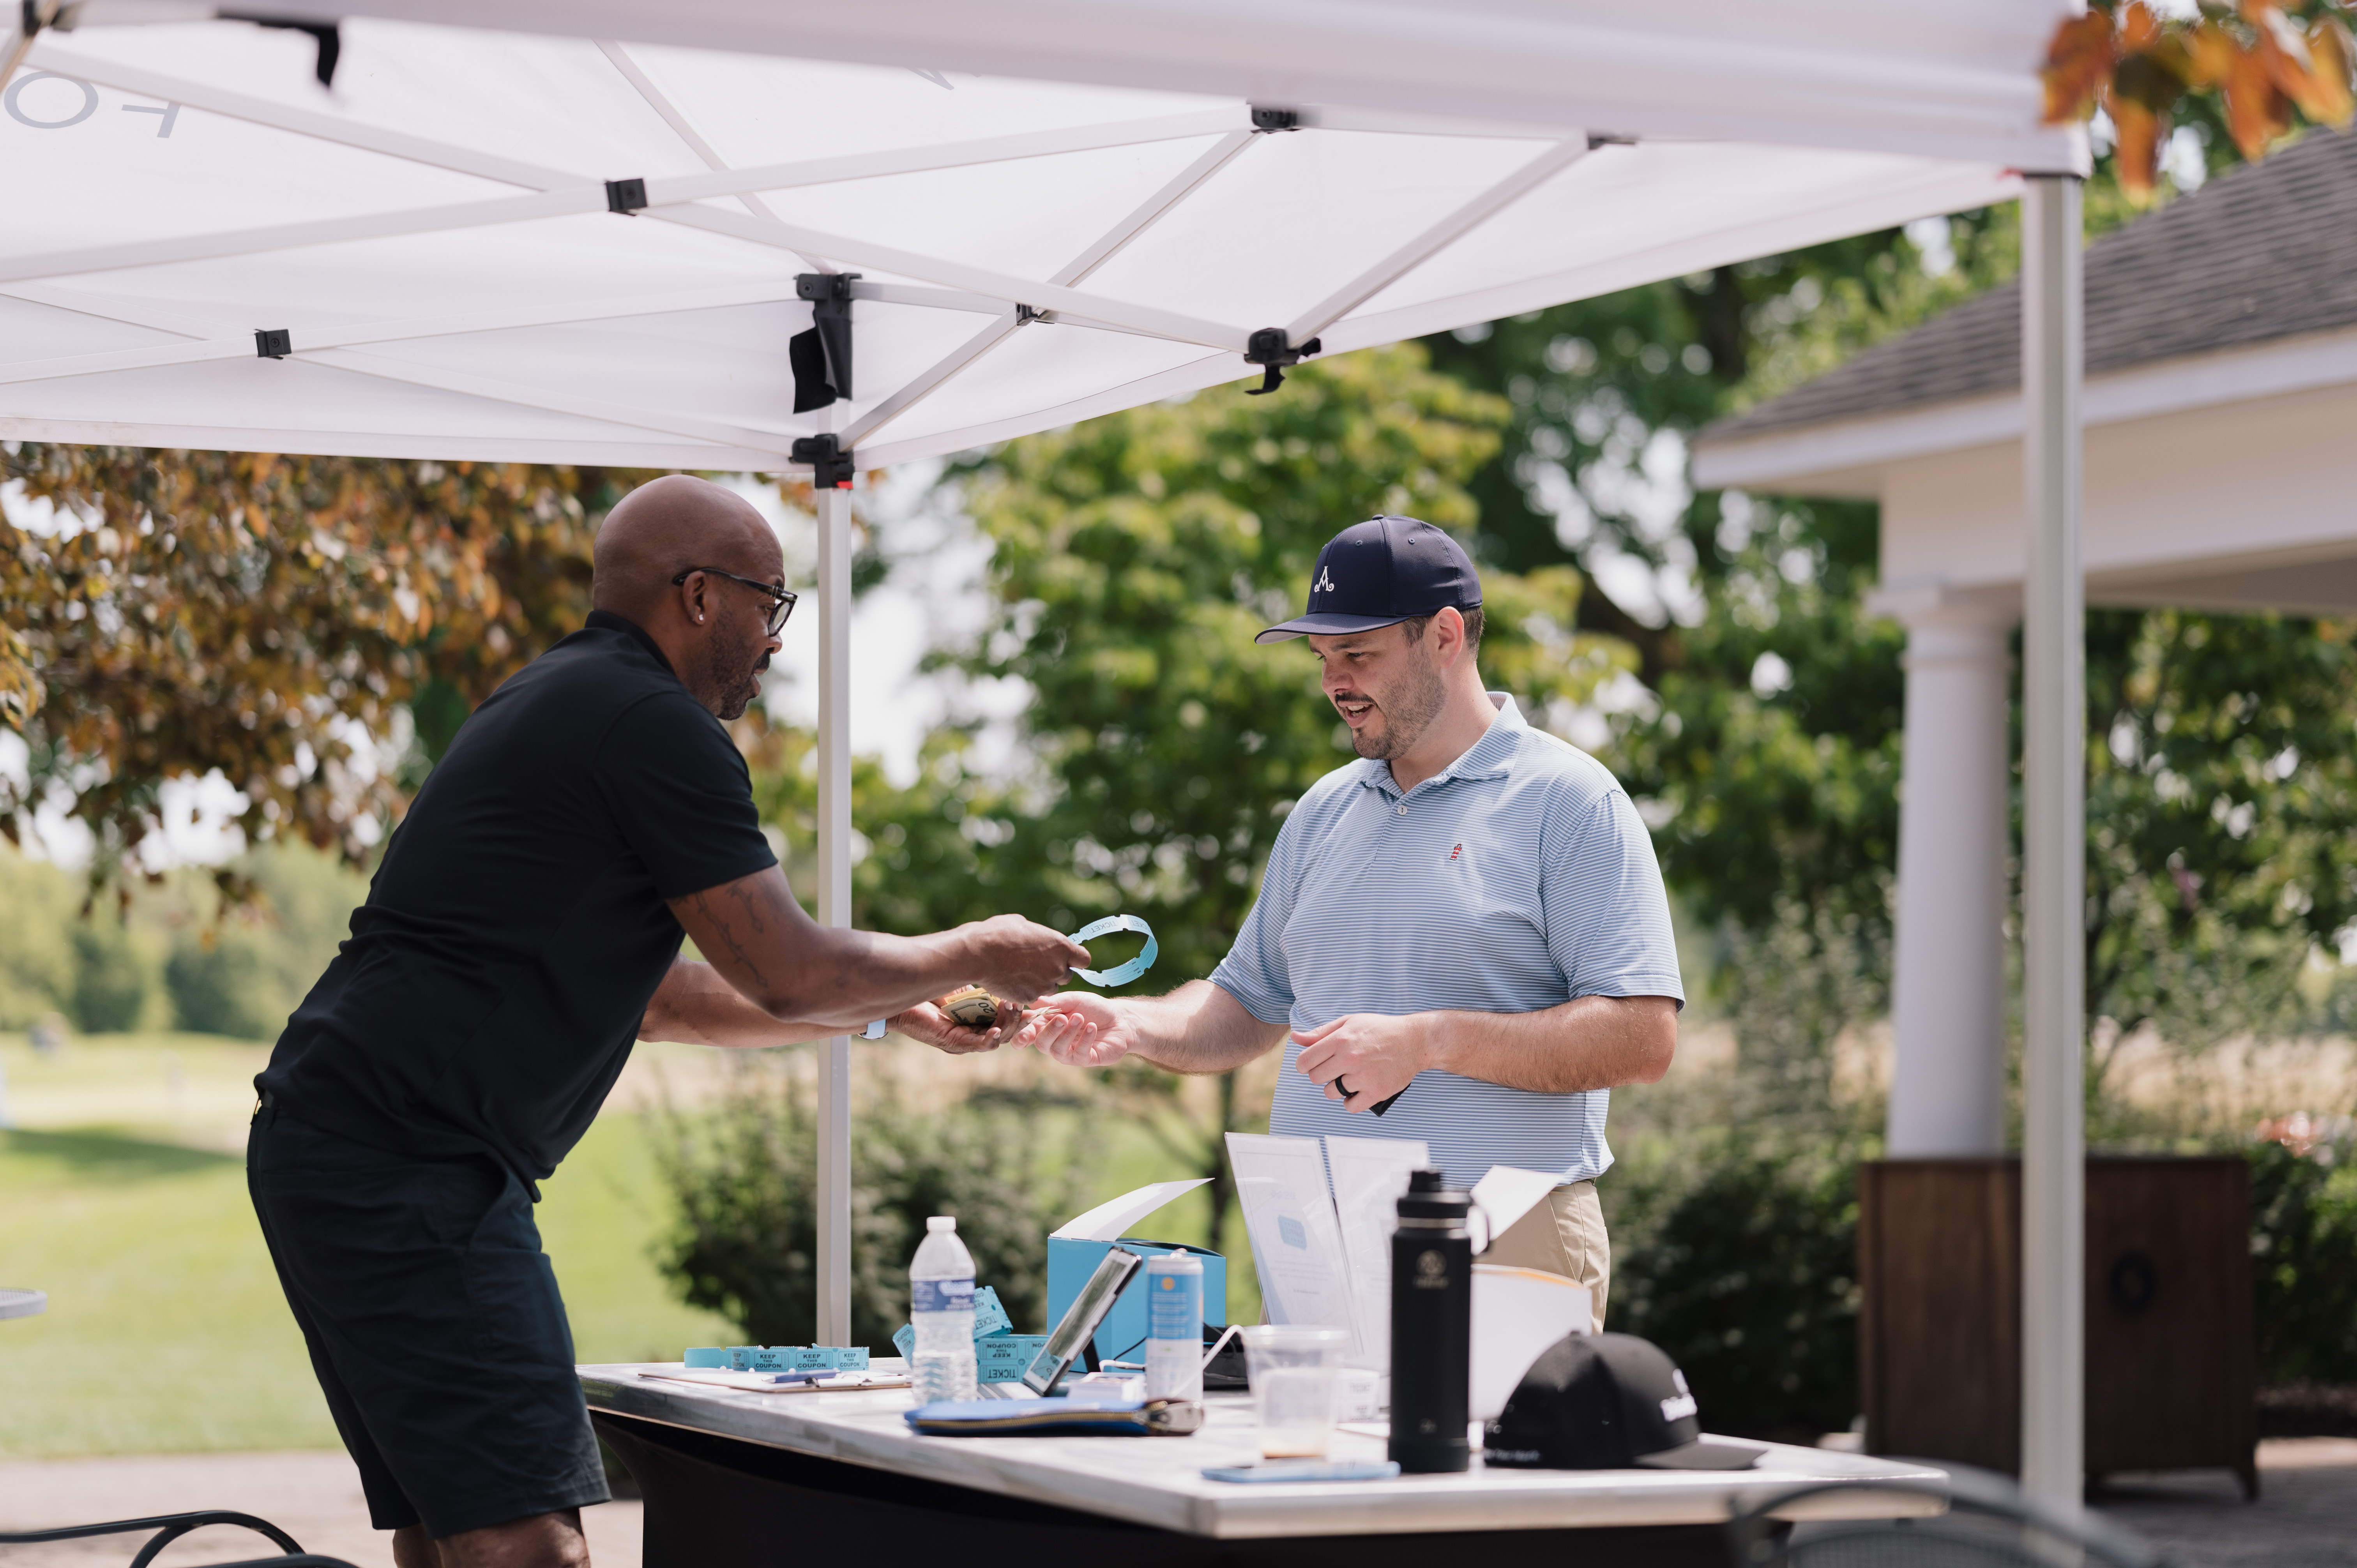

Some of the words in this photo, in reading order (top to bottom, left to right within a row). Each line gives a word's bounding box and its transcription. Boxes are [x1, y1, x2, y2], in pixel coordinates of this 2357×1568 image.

[1314, 566, 1334, 592] A
[1091, 920, 1118, 933] TICKET
[978, 1003, 995, 1014] 20
[975, 1315, 997, 1330] TICKET
[988, 1369, 1016, 1379] TICKET
